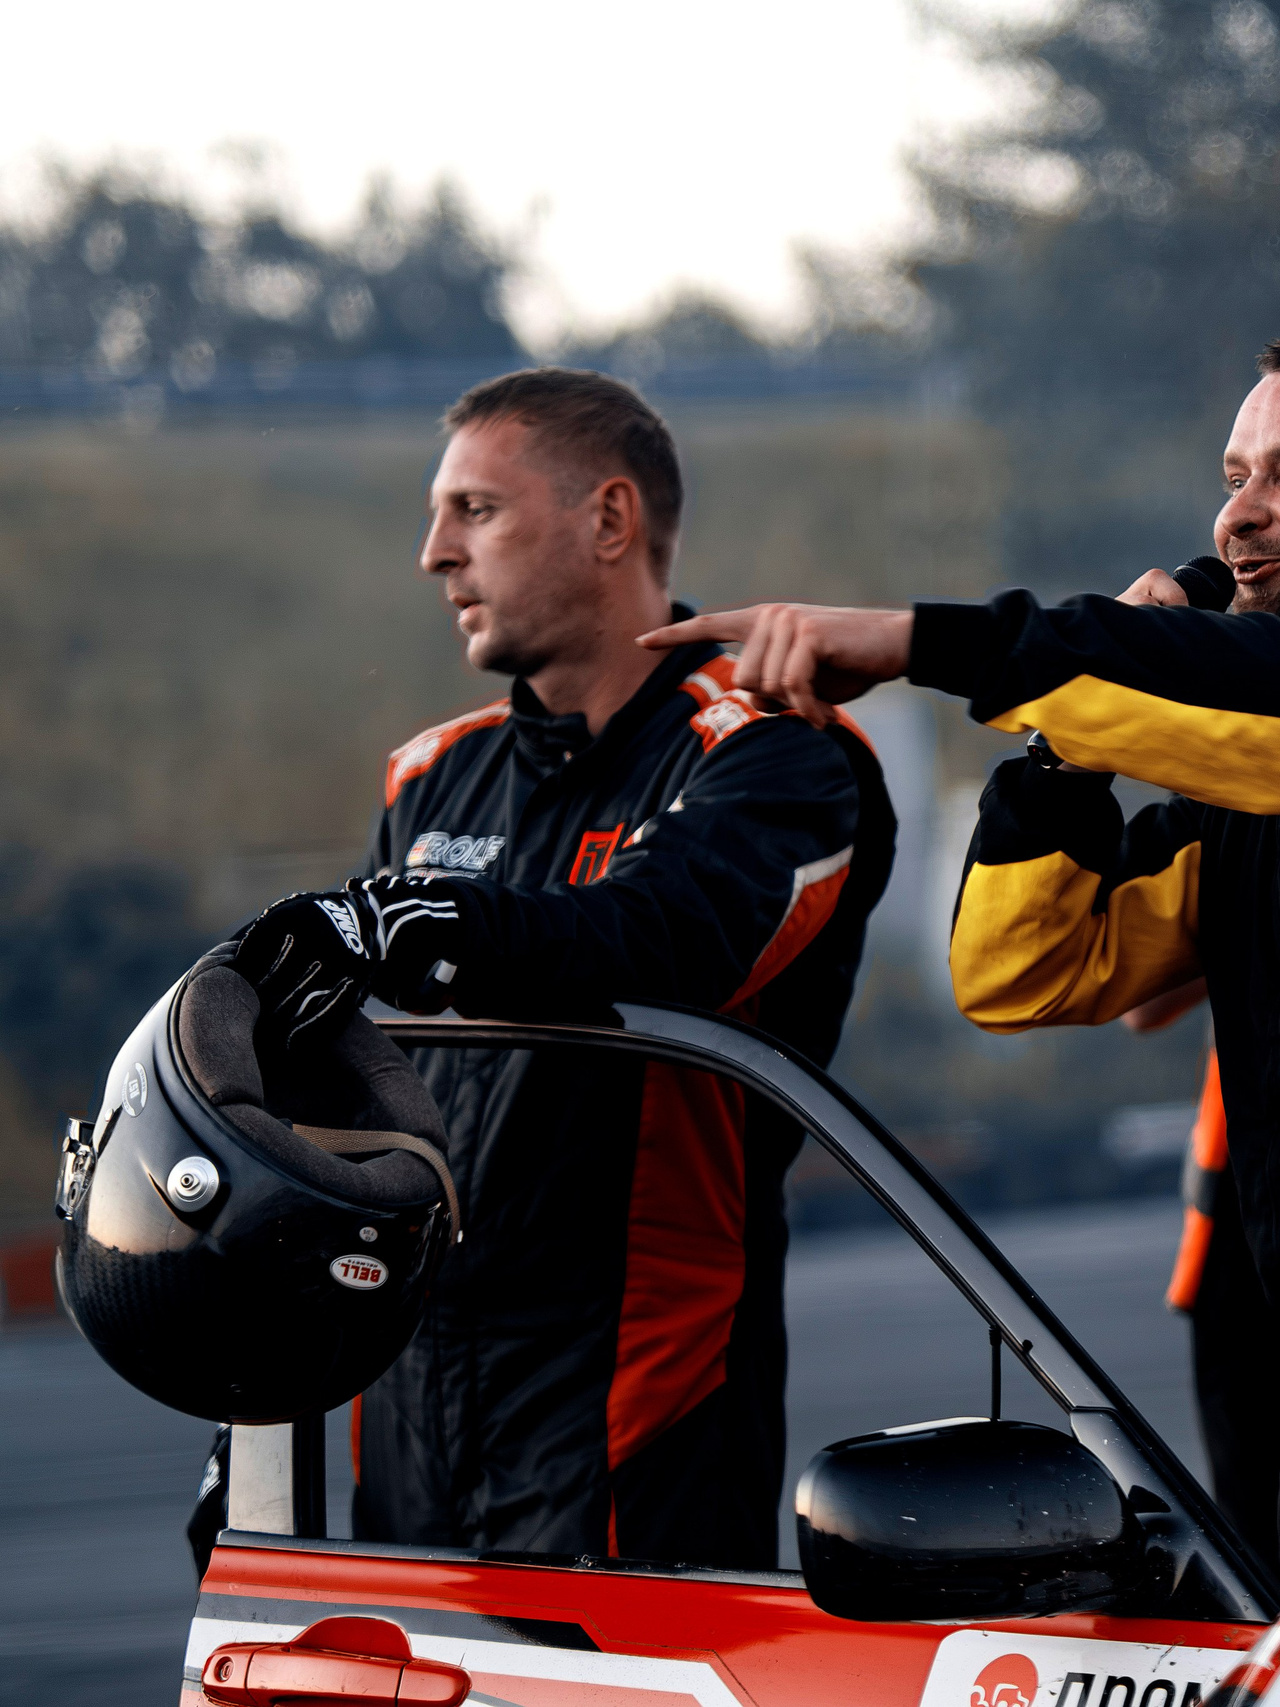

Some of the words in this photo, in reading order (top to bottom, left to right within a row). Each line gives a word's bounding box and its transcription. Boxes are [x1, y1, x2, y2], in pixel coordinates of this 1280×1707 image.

[420, 831, 506, 871] ROLF
[322, 900, 364, 955] OMP
[340, 1263, 381, 1283] BELL
